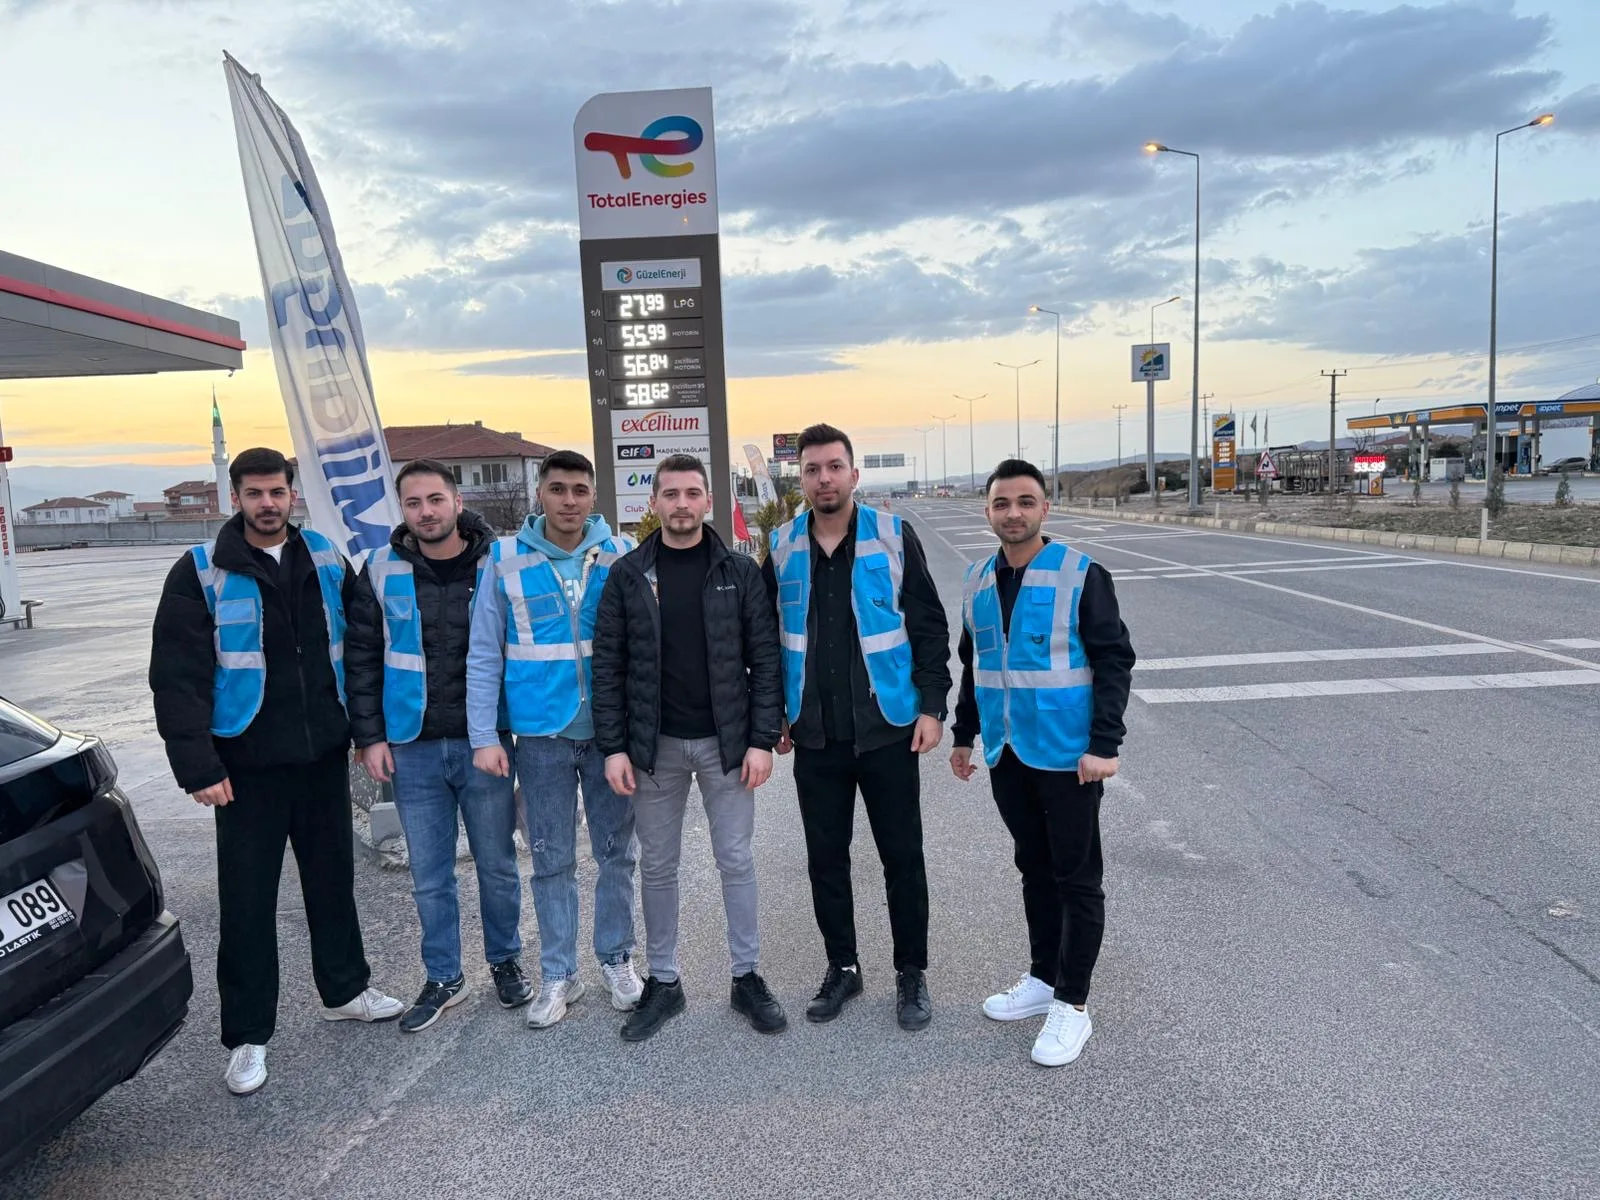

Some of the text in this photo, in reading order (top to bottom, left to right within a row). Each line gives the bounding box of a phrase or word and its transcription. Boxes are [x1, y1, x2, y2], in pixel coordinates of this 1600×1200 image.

[587, 189, 707, 209] TotalEnergies
[636, 268, 687, 280] GüzelEnerji
[673, 298, 695, 309] LPG
[621, 413, 700, 433] excellium
[620, 447, 640, 457] elf
[625, 504, 645, 513] Club
[7, 885, 60, 928] 089
